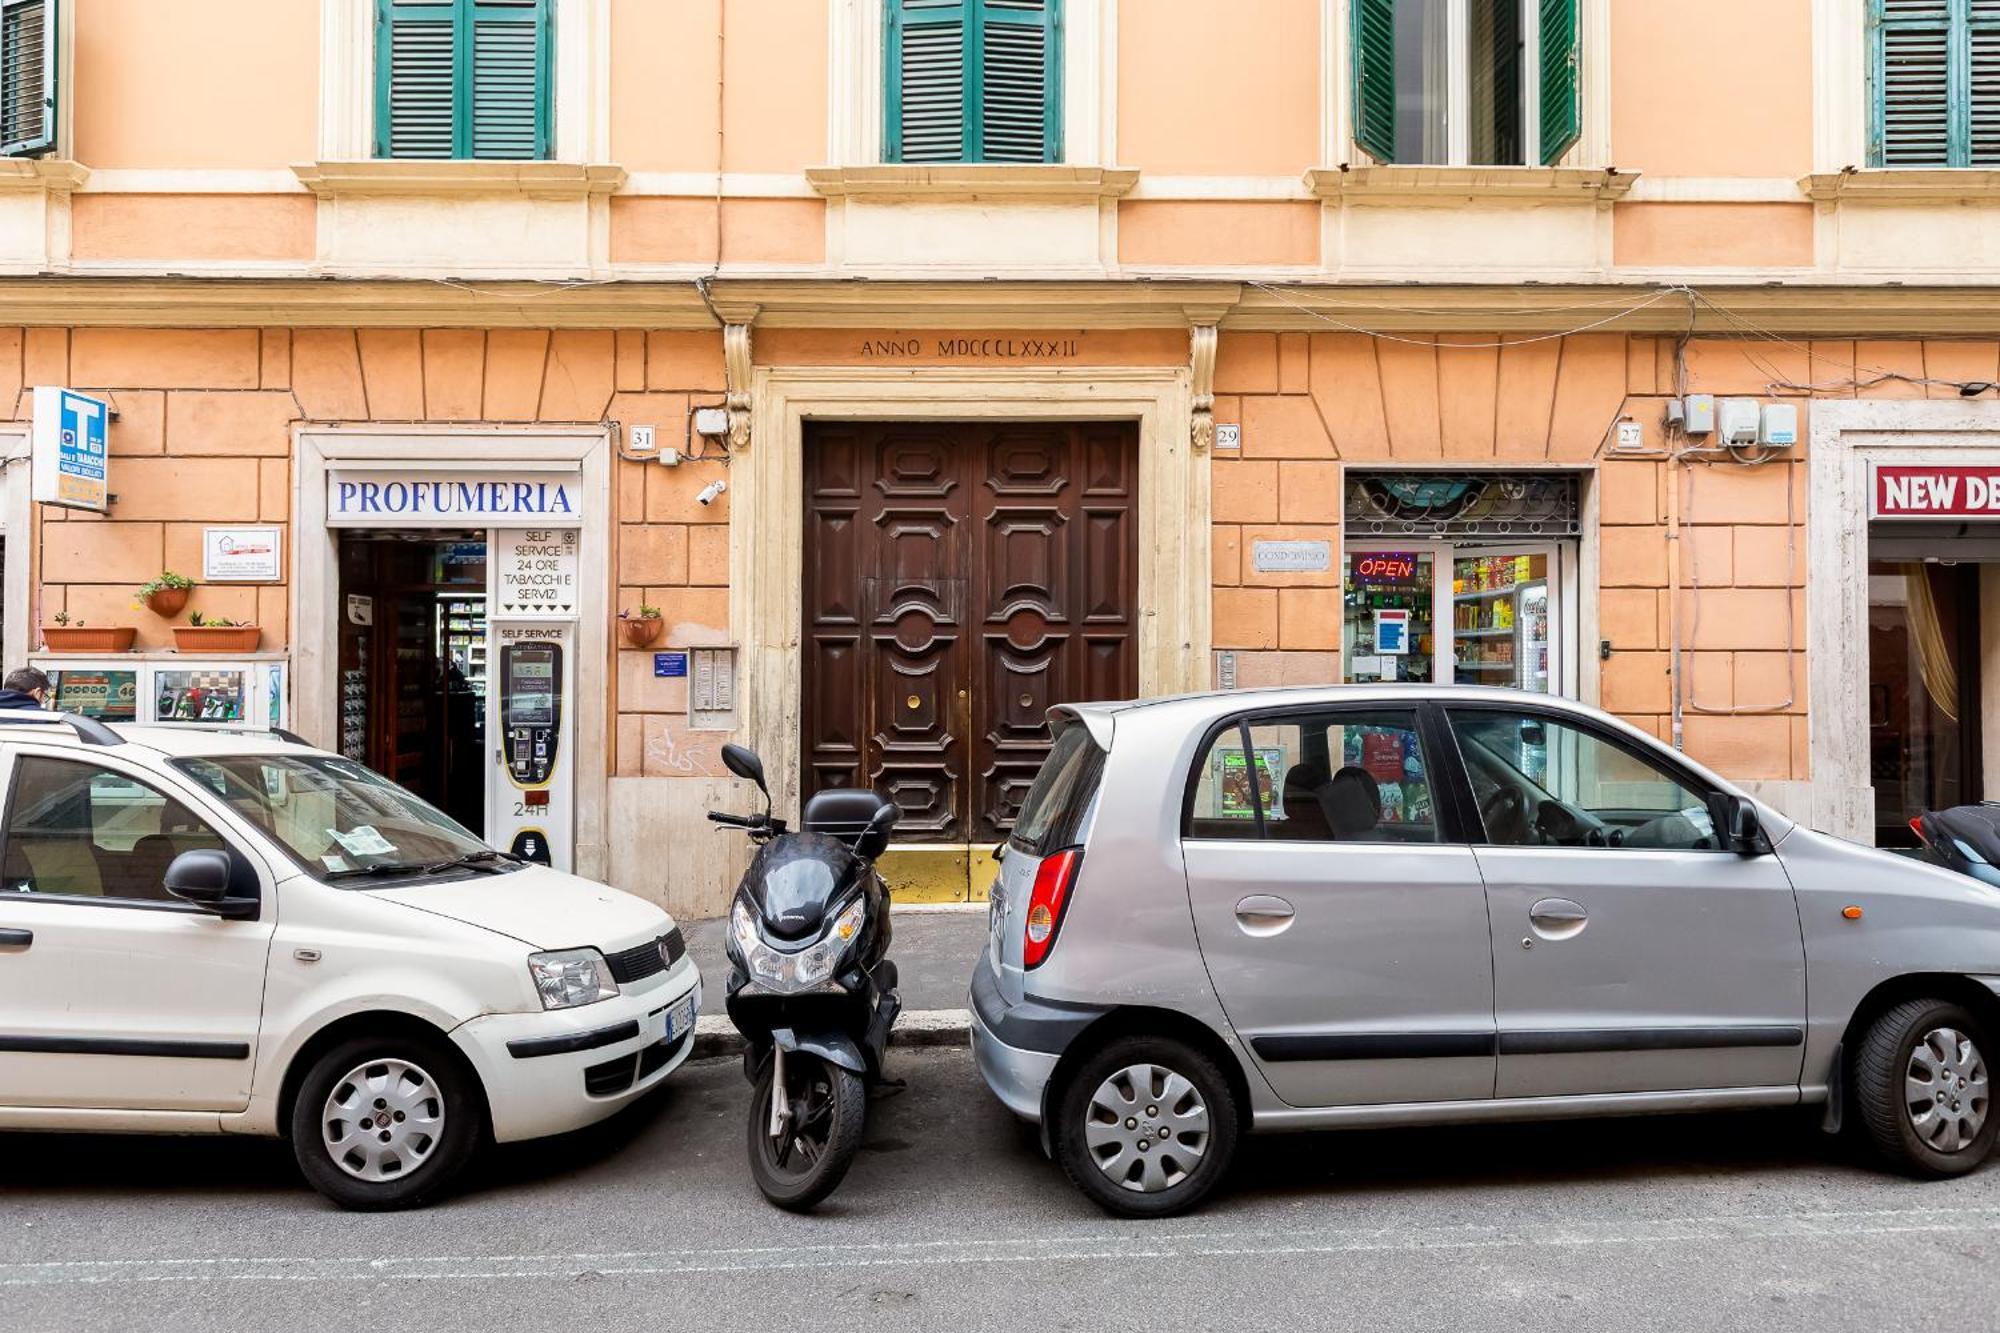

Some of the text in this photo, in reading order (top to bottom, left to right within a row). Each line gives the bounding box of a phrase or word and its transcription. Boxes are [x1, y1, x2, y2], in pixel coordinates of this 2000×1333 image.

[861, 339, 1076, 357] ANNO MDCCCLXXXII
[65, 395, 99, 451] T
[633, 431, 650, 445] 31
[1219, 429, 1237, 442] 29
[1622, 428, 1640, 441] 27
[337, 481, 573, 513] PROFUMERIA
[1882, 473, 1958, 510] NEW
[526, 531, 552, 542] SELF
[515, 545, 561, 556] SERVICE
[517, 559, 560, 571] 24 ORE
[1359, 560, 1412, 577] OPEN
[504, 574, 572, 585] TABACCHI E
[518, 588, 558, 599] SERVIZI
[502, 629, 562, 638] SELF SERVICE
[513, 801, 549, 817] 24H
